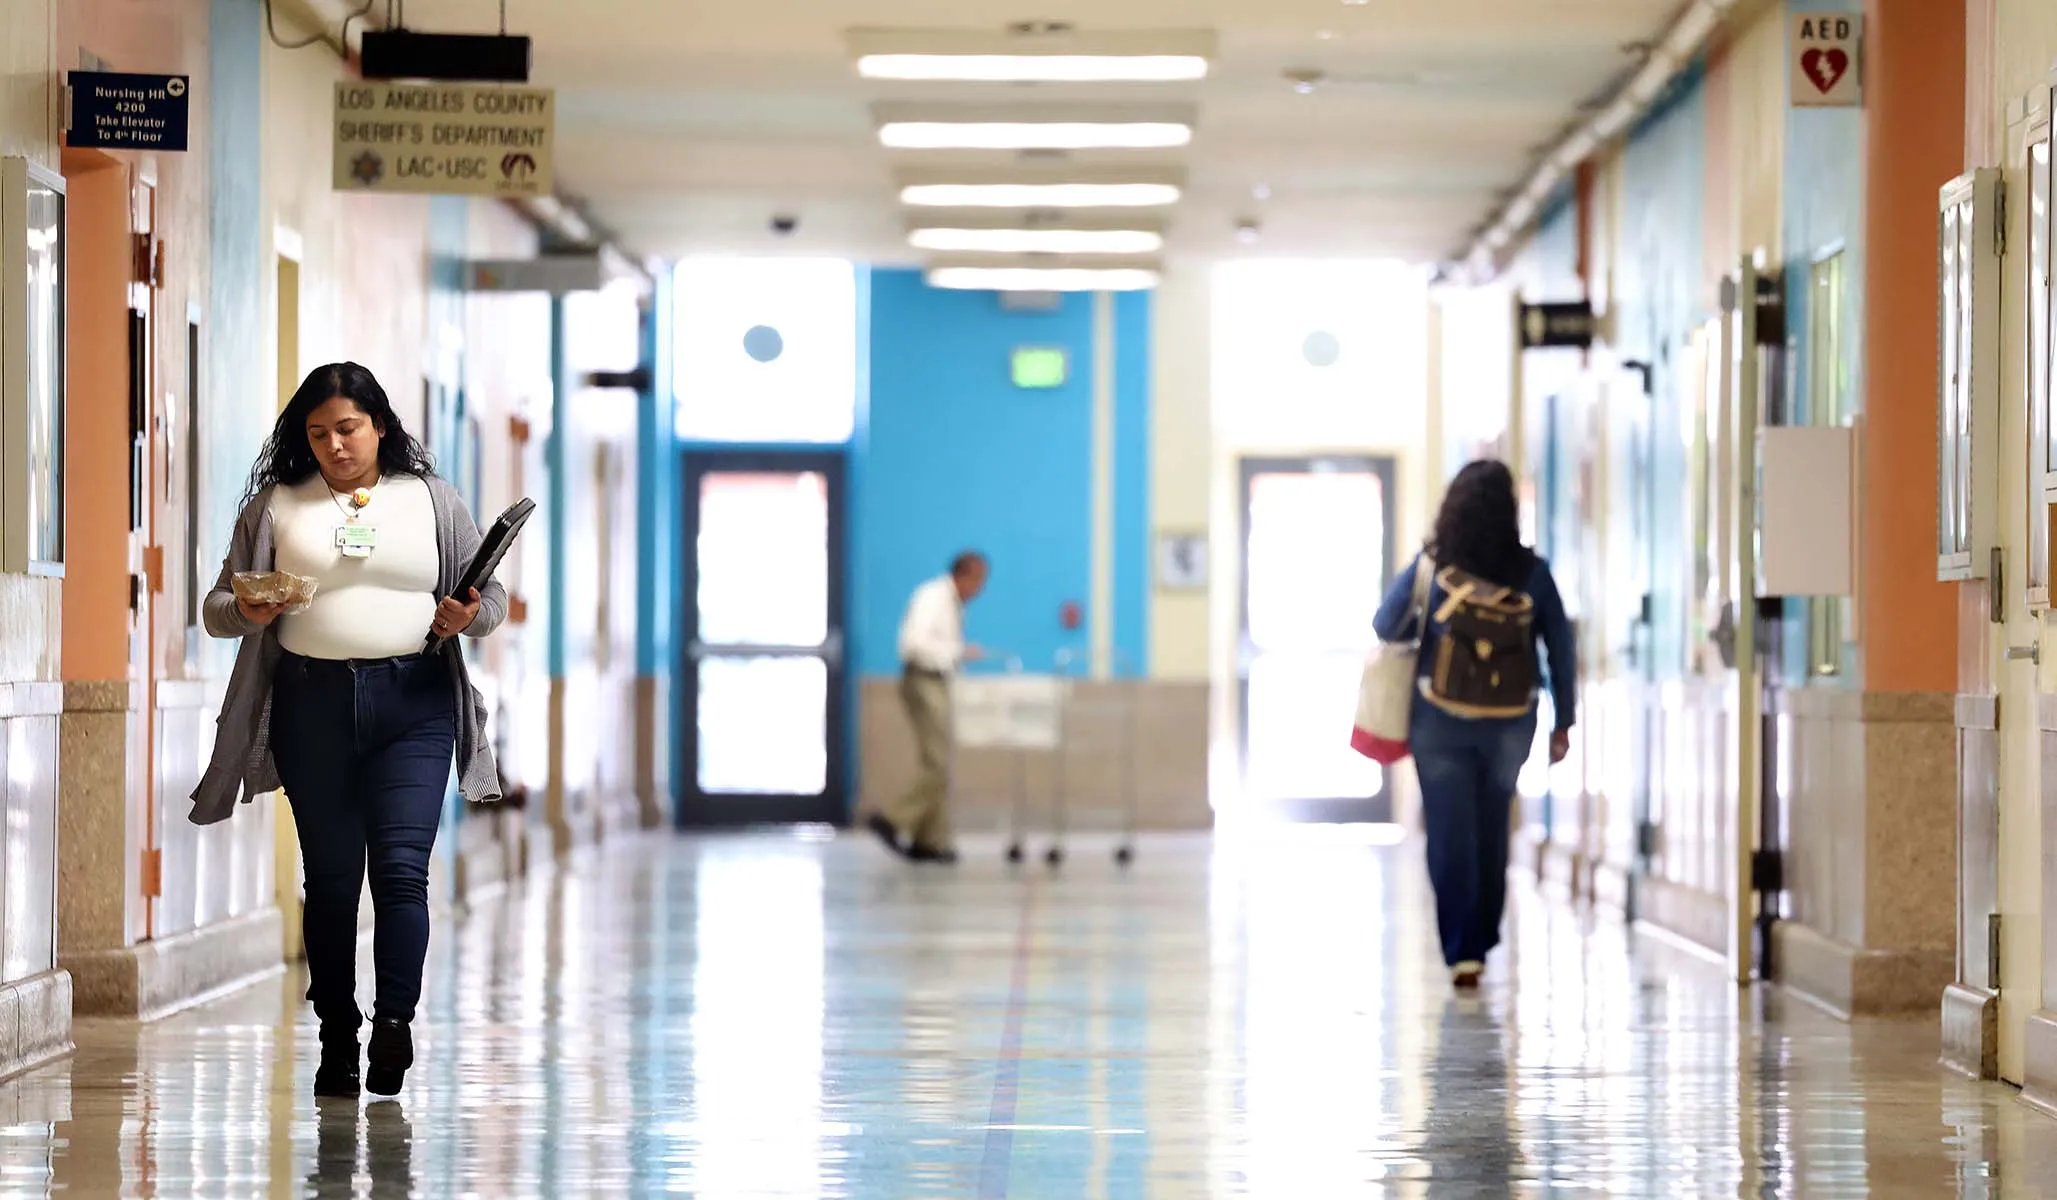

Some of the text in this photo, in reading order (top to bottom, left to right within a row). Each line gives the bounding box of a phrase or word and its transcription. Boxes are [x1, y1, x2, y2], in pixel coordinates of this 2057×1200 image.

[1800, 18, 1849, 41] AED
[95, 86, 166, 101] Nursing HR
[115, 102, 146, 113] 4200
[338, 89, 547, 114] LOS ANGELES COUNTY
[94, 114, 166, 129] Take Elevator
[97, 129, 111, 140] To
[131, 131, 163, 142] Floor
[339, 120, 545, 147] SHERIFF'S DEPARTMENT
